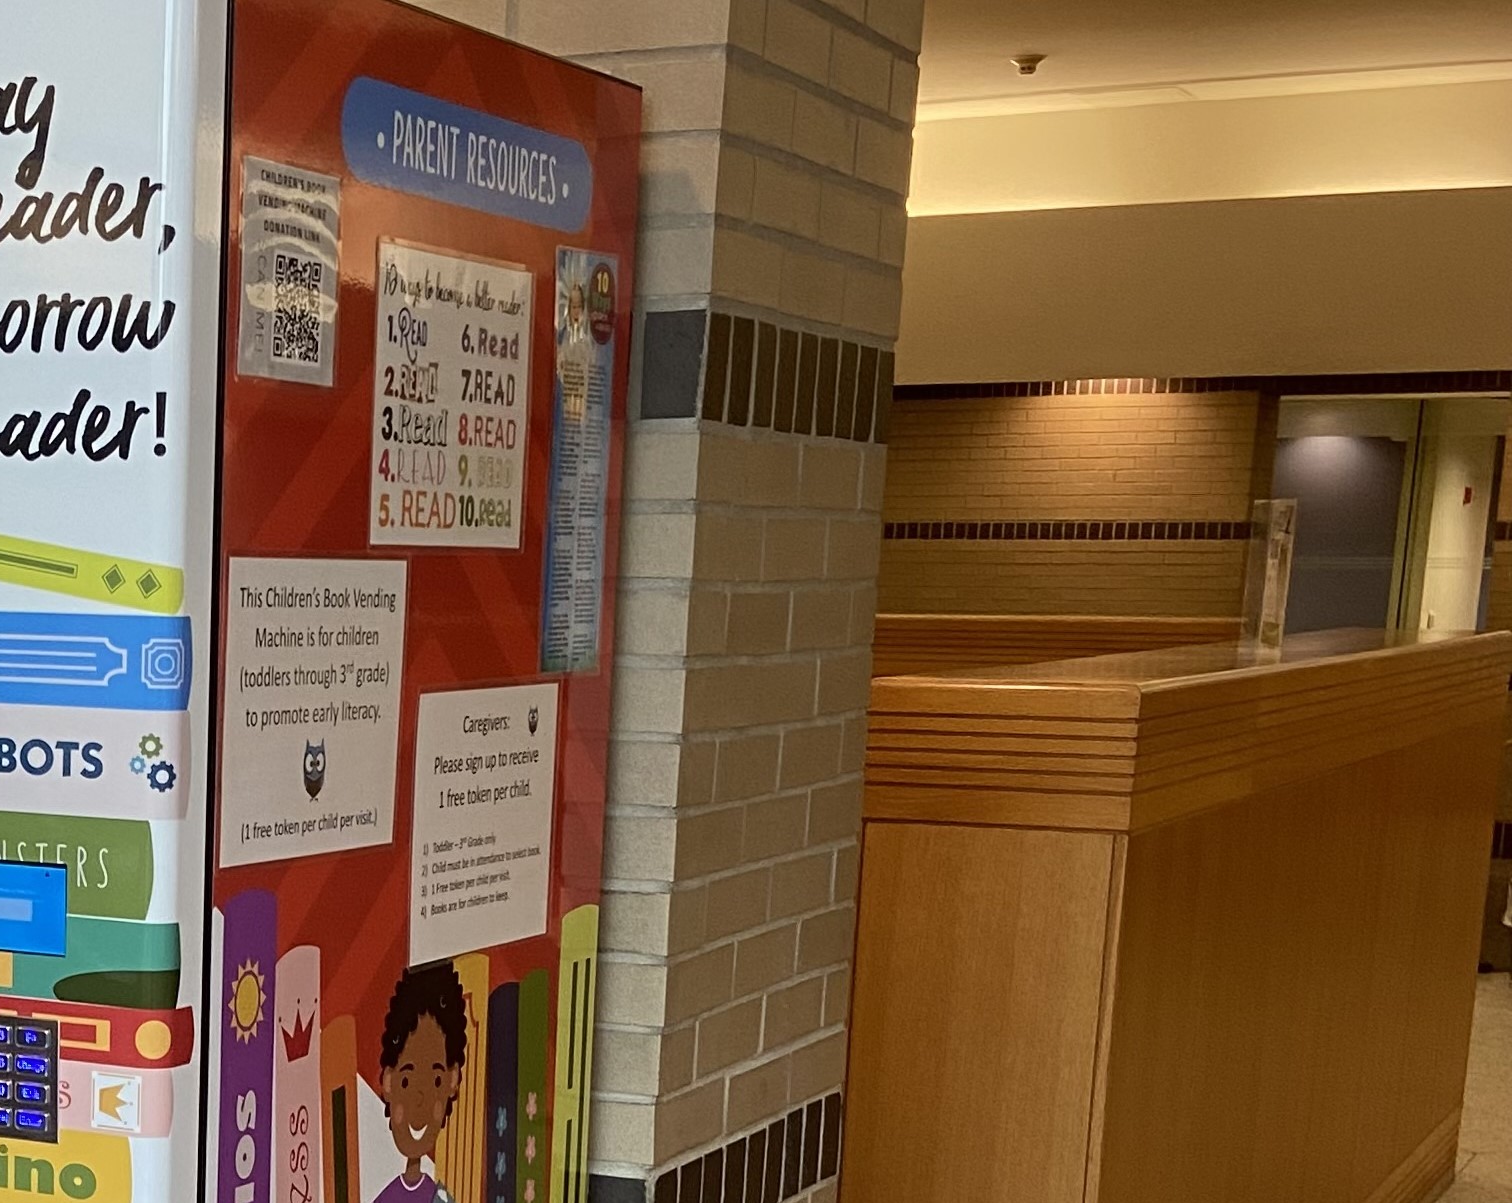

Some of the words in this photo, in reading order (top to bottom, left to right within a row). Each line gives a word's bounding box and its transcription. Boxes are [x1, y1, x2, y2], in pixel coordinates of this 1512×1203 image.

[391, 109, 461, 181] PARENT
[466, 132, 557, 206] RESOURCES
[263, 219, 303, 239] DONATION
[461, 323, 475, 355] 6.
[477, 327, 520, 361] Read
[474, 369, 516, 407] READ
[398, 404, 449, 447] Read
[474, 415, 517, 450] READ
[397, 448, 447, 486] READ
[378, 493, 395, 528] 5.
[400, 489, 457, 530] READ
[239, 586, 263, 608] This
[265, 586, 321, 609] Children's
[323, 587, 351, 609] Book
[352, 587, 397, 613] Vending
[255, 626, 304, 648] Machine
[306, 626, 316, 647] is
[318, 625, 334, 647] for
[336, 624, 379, 646] children
[240, 665, 291, 693] (toddlers
[293, 663, 337, 690] through
[356, 661, 390, 688] grade)
[246, 708, 258, 727] to
[261, 705, 310, 732] promote
[312, 701, 340, 727] early
[341, 700, 381, 724] literacy.
[462, 713, 511, 736] Caregivers:
[434, 755, 464, 775] Please
[465, 752, 483, 775] sign
[485, 754, 497, 773] up
[498, 751, 508, 767] to
[509, 746, 539, 766] receive
[439, 791, 445, 809] 1
[447, 788, 466, 807] free
[467, 784, 492, 804] token
[493, 785, 509, 805] per
[509, 778, 532, 798] child.
[241, 823, 251, 844] (1
[253, 821, 272, 839] free
[274, 818, 300, 836] token
[301, 818, 317, 837] per
[317, 812, 339, 831] child
[339, 814, 354, 832] per
[355, 807, 378, 827] visit.)
